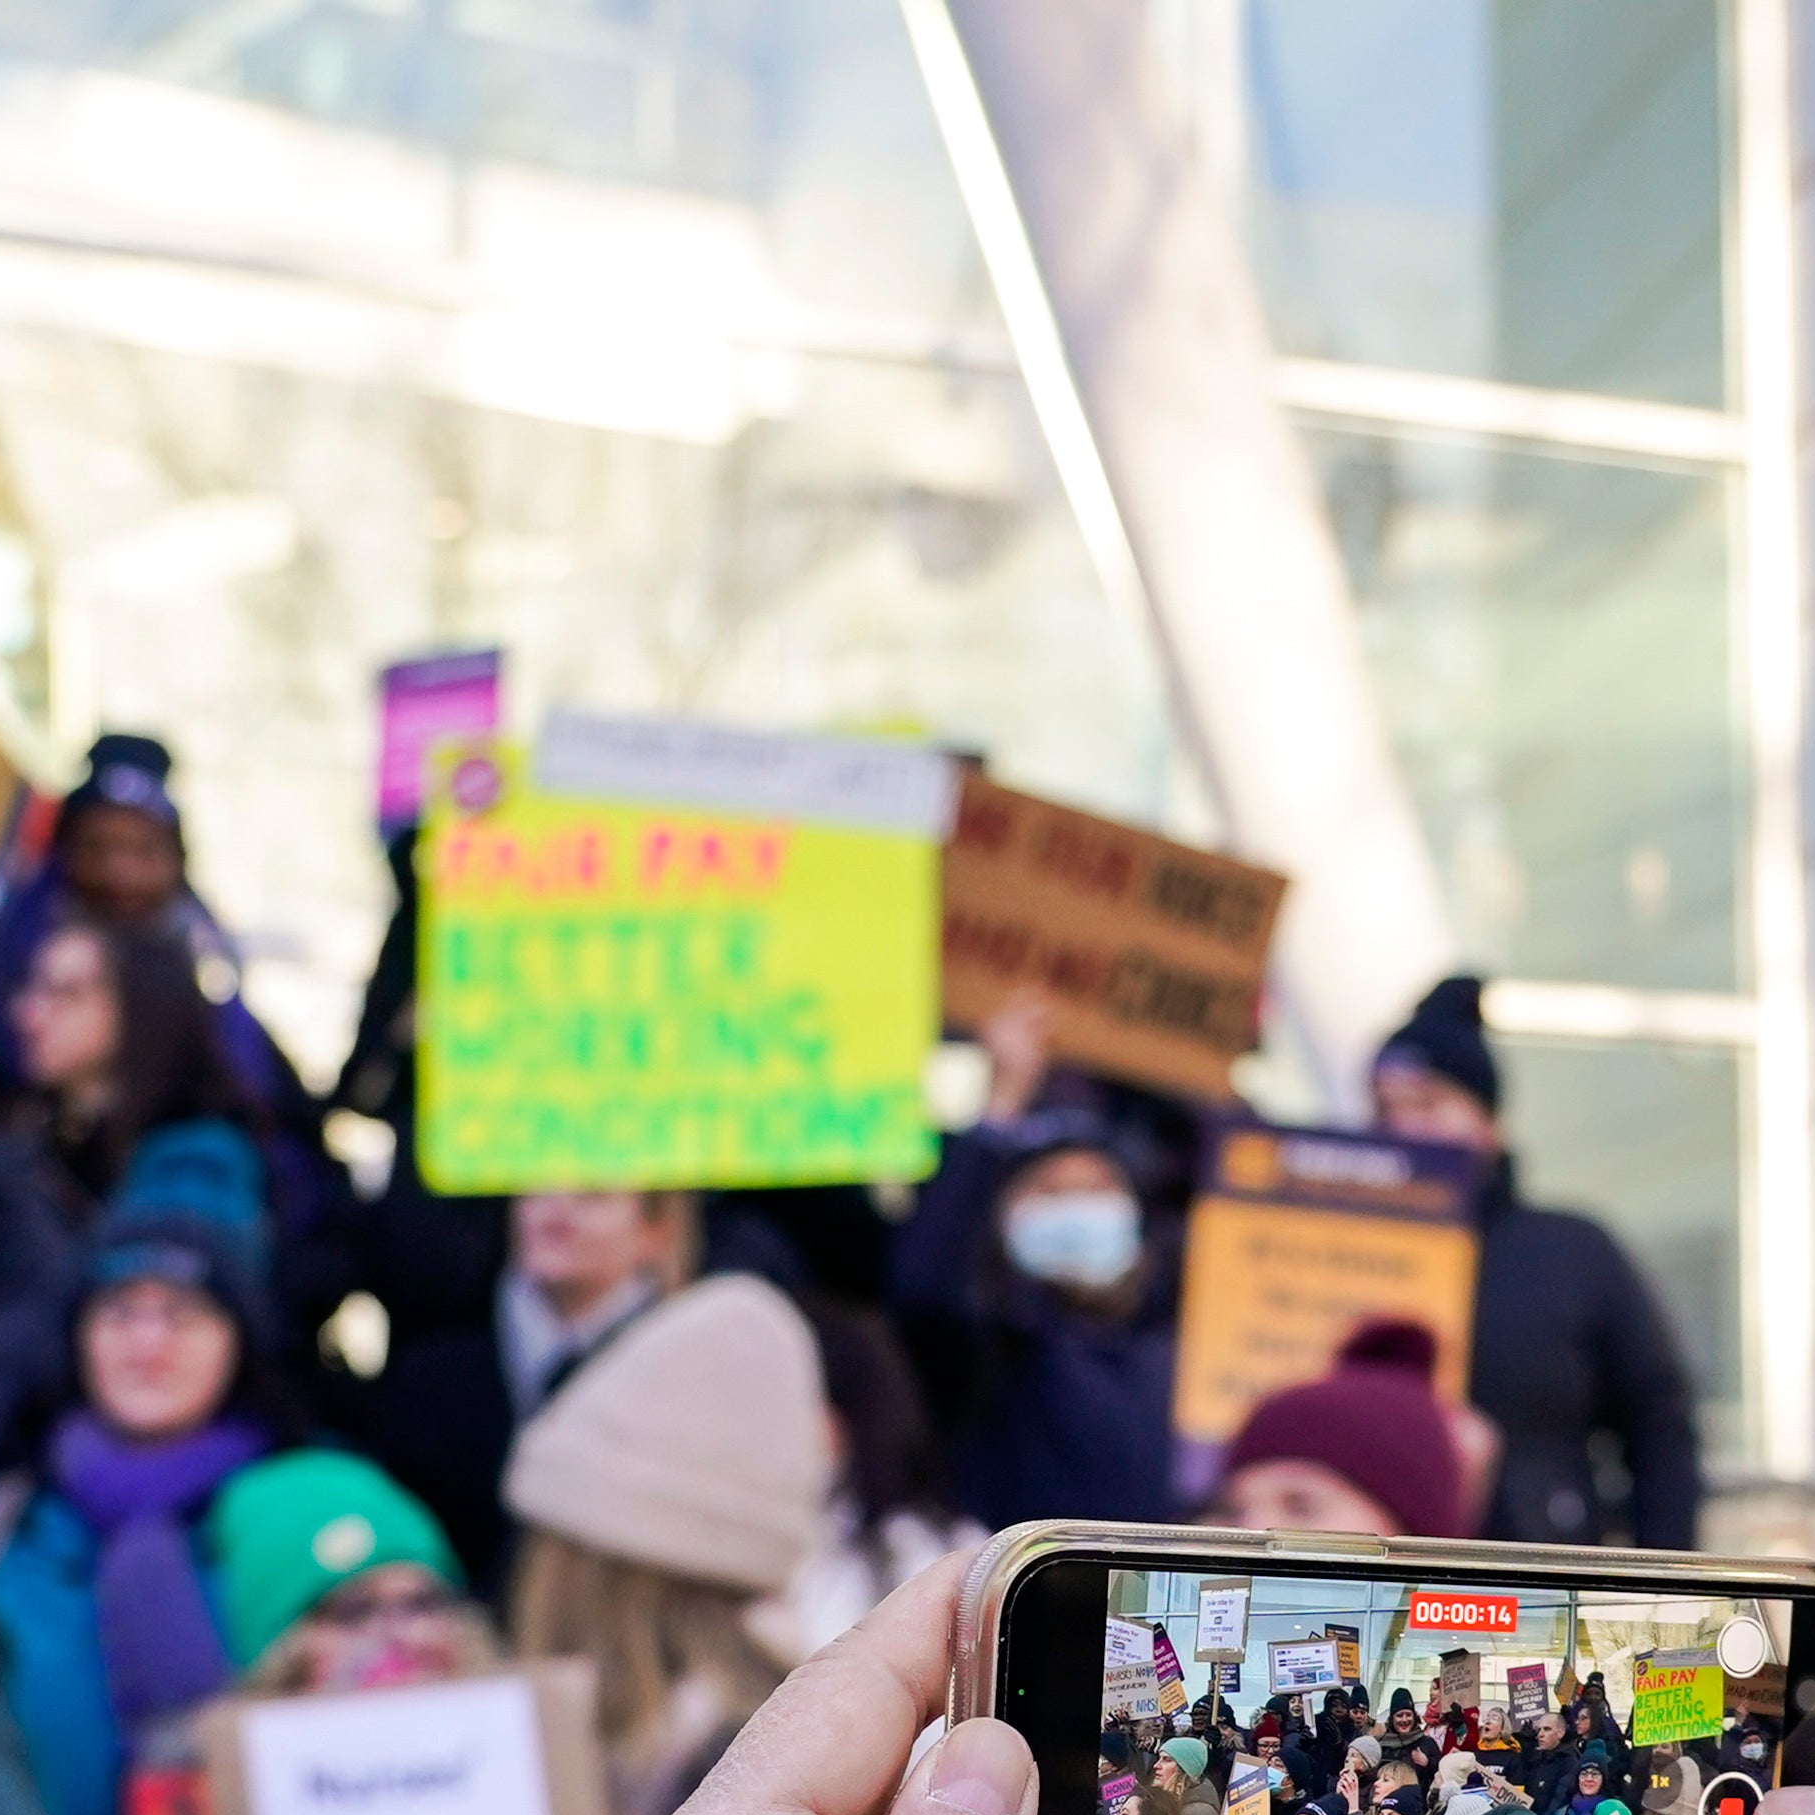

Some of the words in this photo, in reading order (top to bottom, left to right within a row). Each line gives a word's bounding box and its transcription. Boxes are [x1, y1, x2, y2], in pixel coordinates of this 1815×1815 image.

[1415, 1601, 1512, 1626] 00:00:14
[1636, 1674, 1667, 1692] FAIR
[1670, 1667, 1698, 1686] PAY
[1635, 1687, 1693, 1710] BETTER
[1635, 1700, 1705, 1727] WORKING
[1635, 1717, 1723, 1744] CONDITIONS
